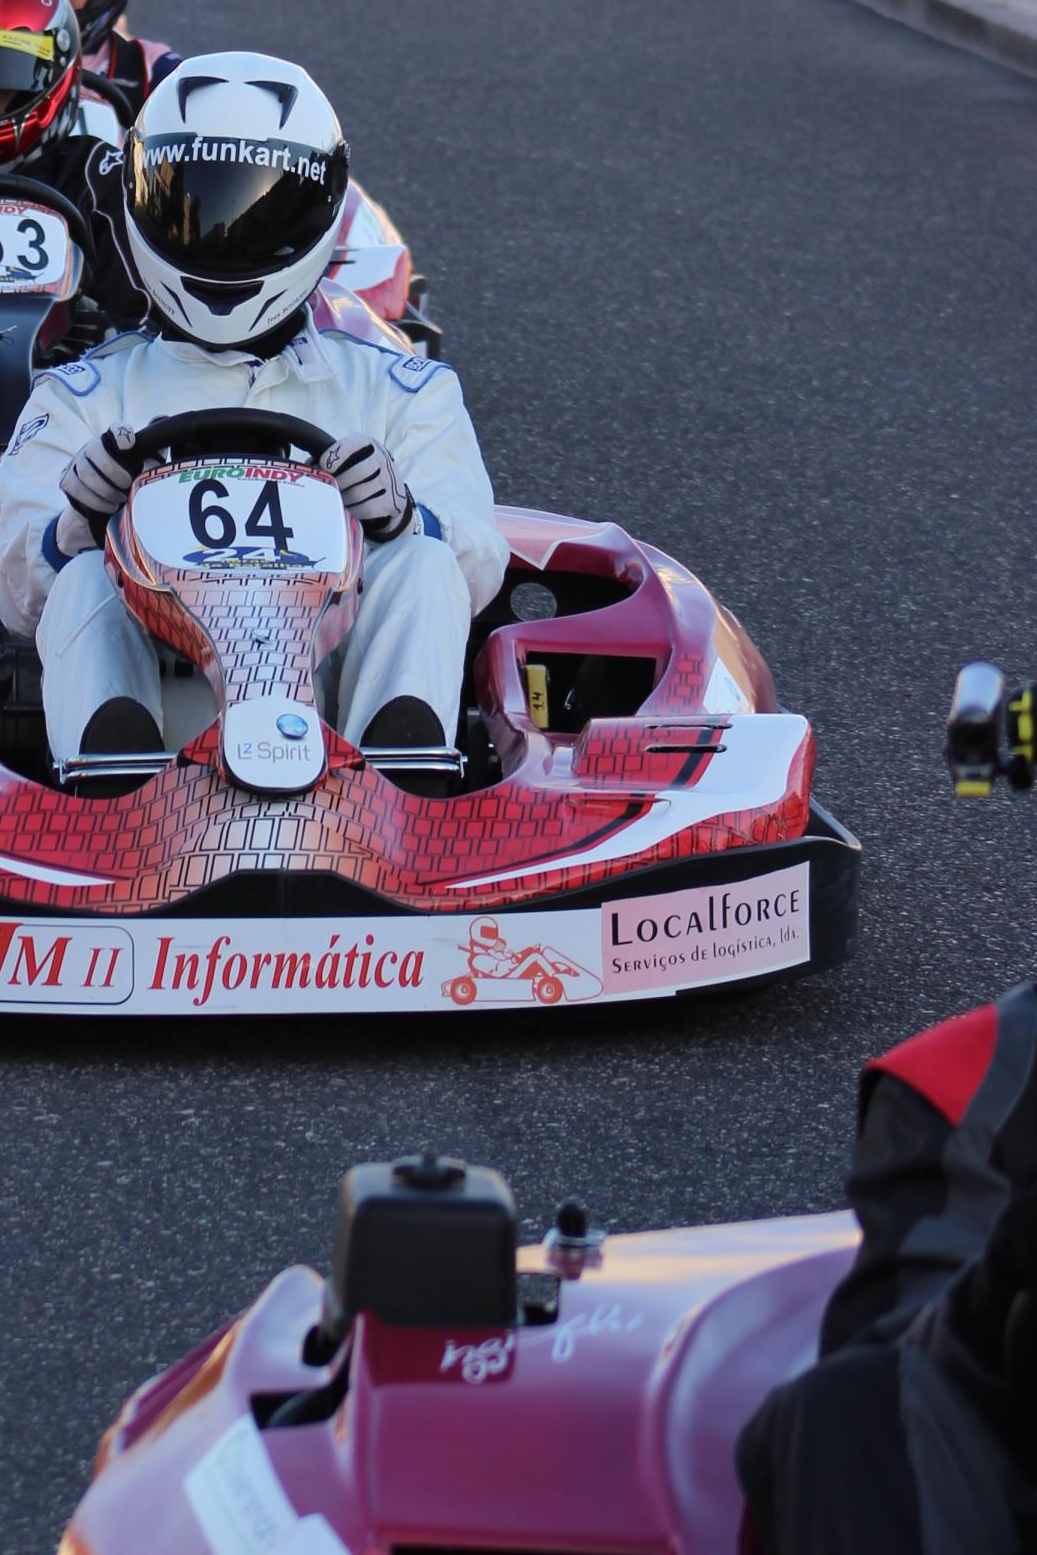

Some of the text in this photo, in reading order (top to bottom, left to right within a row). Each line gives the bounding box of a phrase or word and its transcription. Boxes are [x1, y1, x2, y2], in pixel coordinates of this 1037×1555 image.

[142, 137, 326, 186] www.funkart.net
[178, 465, 304, 484] EUROINDY
[189, 478, 294, 553] 64
[257, 741, 312, 764] Spirit
[80, 947, 125, 988] II
[147, 932, 425, 1006] Informática
